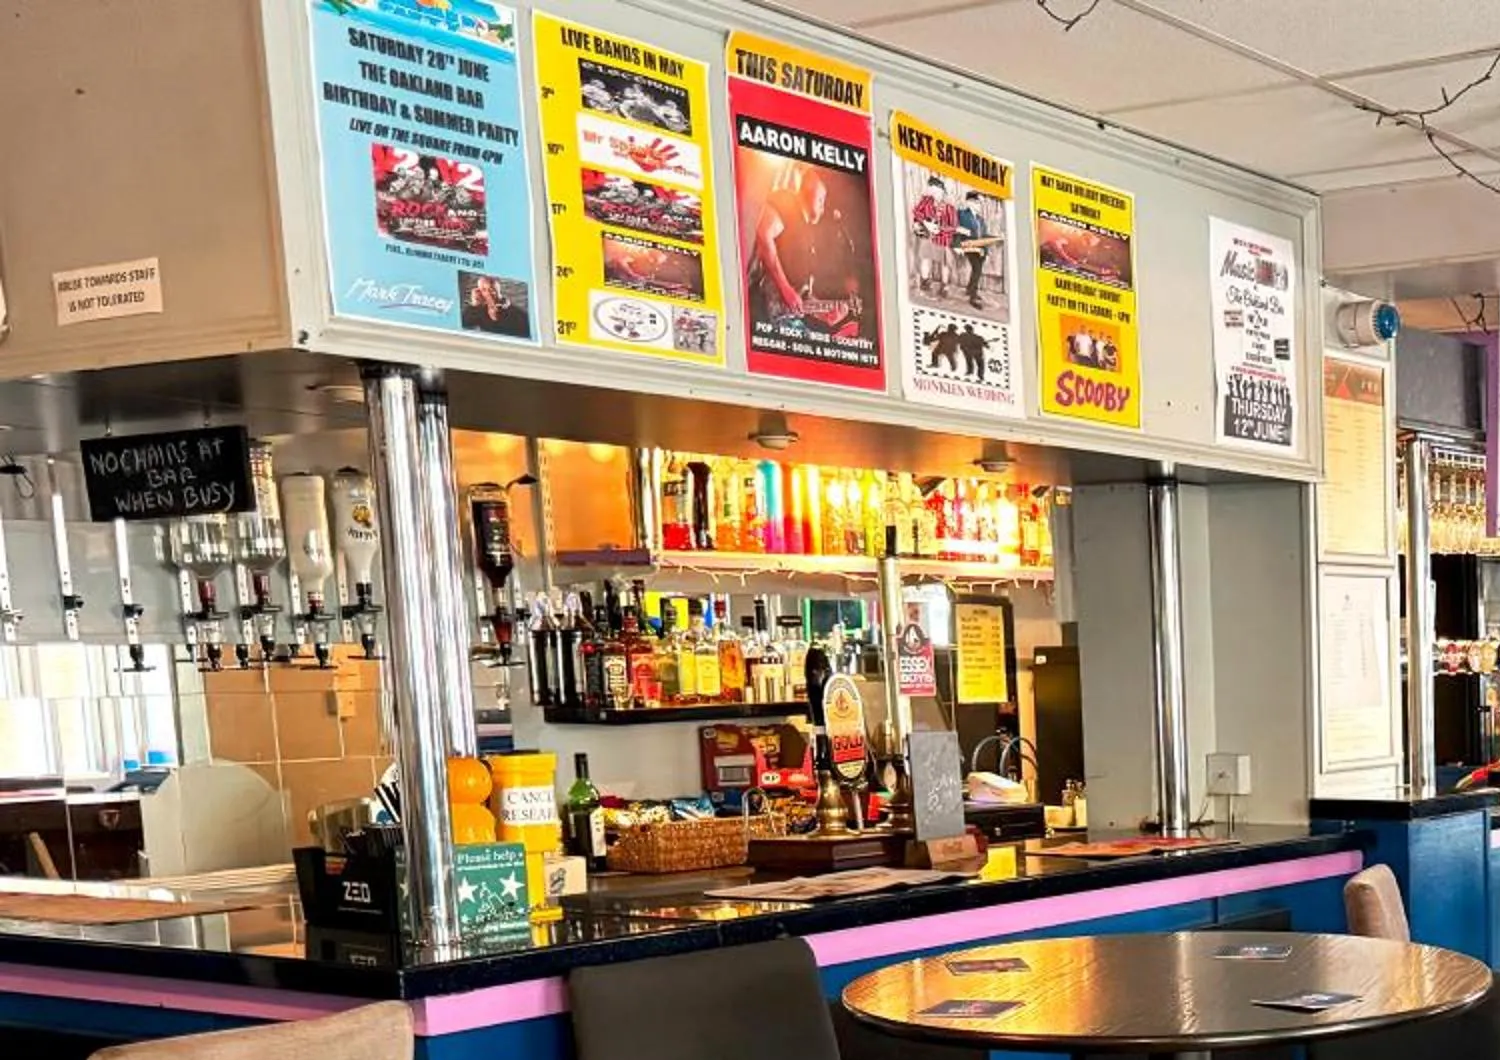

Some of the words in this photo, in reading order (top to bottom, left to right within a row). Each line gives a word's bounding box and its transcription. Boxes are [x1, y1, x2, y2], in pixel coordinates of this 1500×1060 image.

[347, 27, 424, 65] SATURDAY
[458, 57, 490, 82] JUNE
[560, 26, 591, 51] LIVE
[593, 35, 641, 65] BANDS
[644, 50, 657, 72] IN
[659, 55, 686, 80] MAY
[358, 61, 386, 83] THE
[390, 68, 453, 101] OAKLAND
[457, 87, 485, 110] BAR
[736, 48, 777, 84] THIS
[781, 61, 864, 108] SATURDAY
[323, 82, 397, 116] BIRTHDAY
[400, 103, 412, 120] &
[414, 104, 475, 137] SUMMER
[477, 120, 519, 146] PARTY
[350, 118, 372, 134] LIVE
[374, 124, 389, 137] ON
[391, 127, 410, 142] THE
[411, 131, 452, 153] SQUARE
[452, 142, 481, 160] FROM
[740, 121, 806, 157] AARON
[811, 139, 866, 172] KELLY
[898, 123, 933, 157] NEXT
[935, 138, 1008, 188] SATURDAY
[84, 272, 127, 288] TOWARDS
[129, 267, 156, 282] STAFF
[345, 277, 399, 303] Mark
[78, 297, 95, 311] NOT
[97, 291, 145, 308] TOLERATED
[756, 321, 773, 333] POP
[780, 326, 802, 338] ROCK
[752, 336, 786, 350] REGGAE
[792, 342, 814, 355] SOUL
[823, 346, 859, 361] MOTOWN
[1055, 369, 1131, 413] SCOOBY
[1232, 397, 1287, 423] THURSDAY
[1254, 420, 1286, 442] JUNE
[147, 467, 197, 489] BAR
[113, 489, 174, 513] WHEN
[183, 480, 235, 512] BUSY
[456, 850, 491, 864] Please
[493, 850, 515, 863] help
